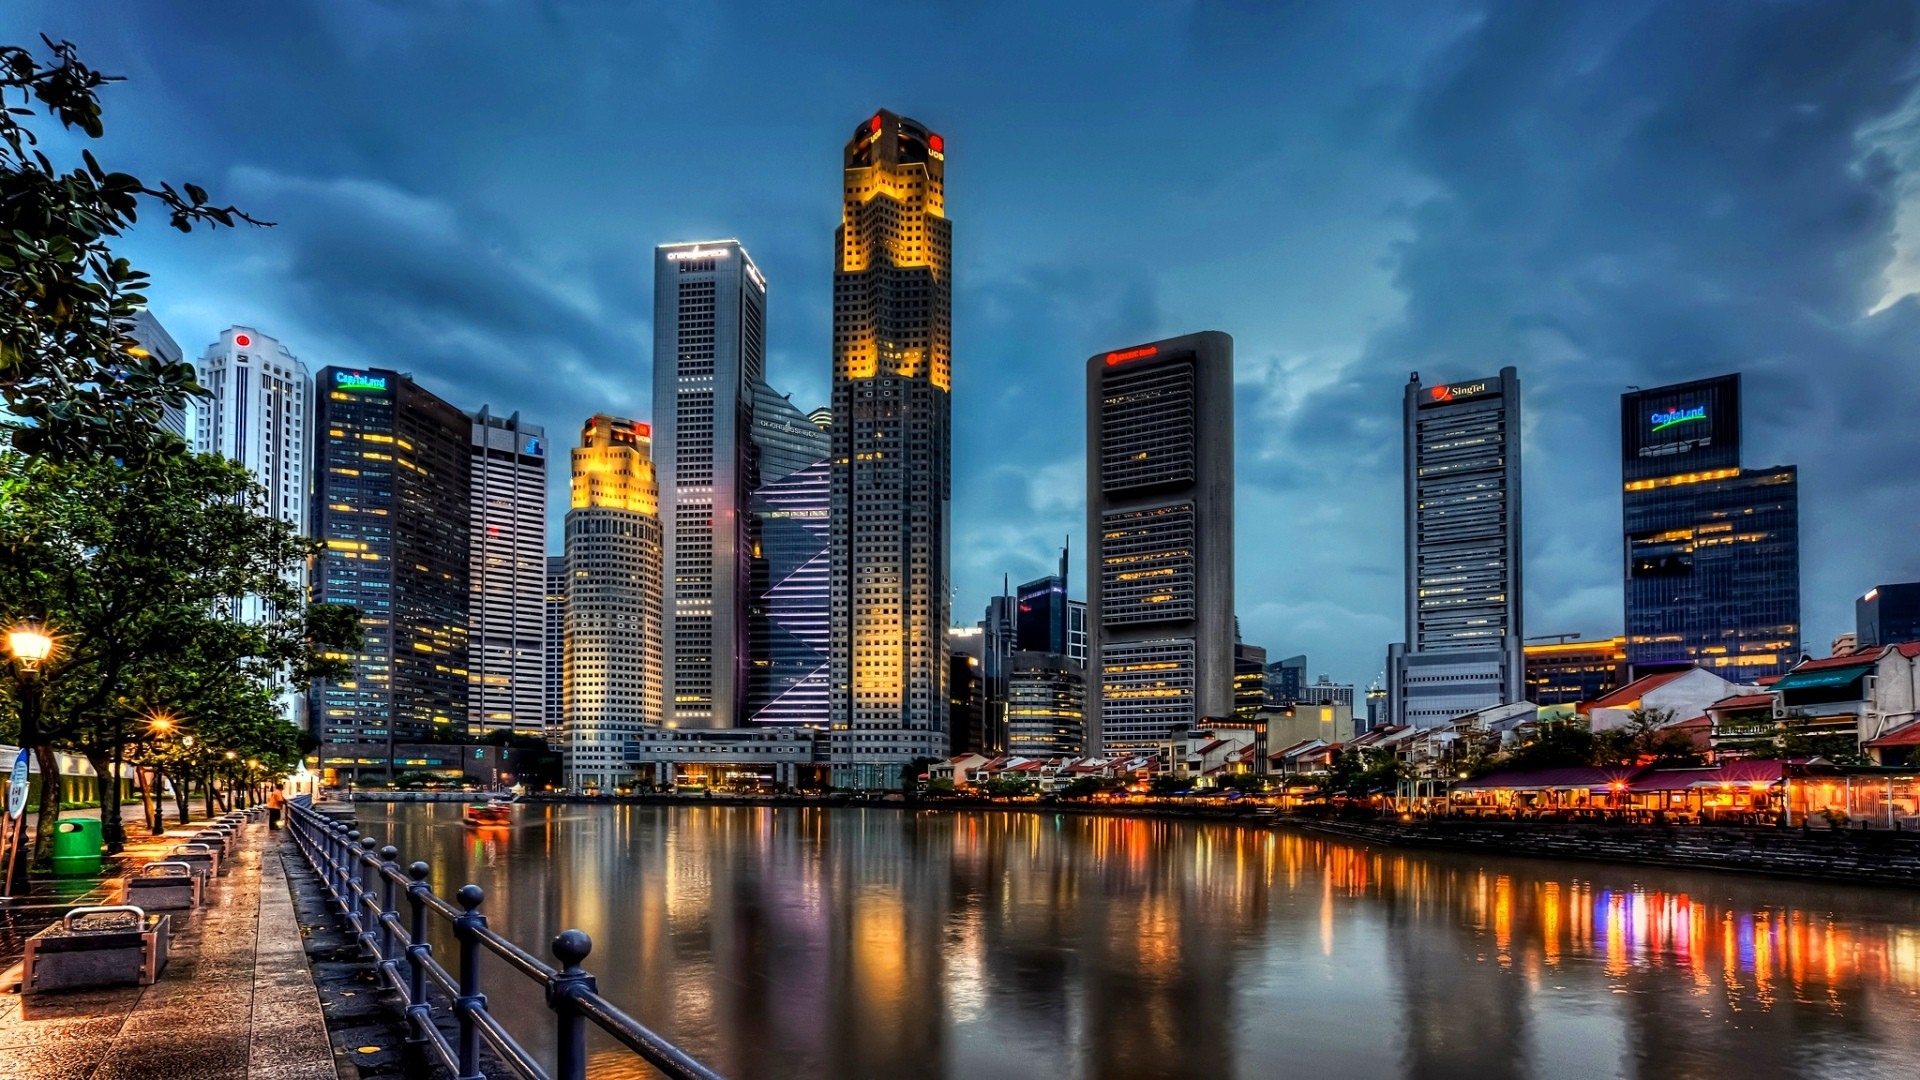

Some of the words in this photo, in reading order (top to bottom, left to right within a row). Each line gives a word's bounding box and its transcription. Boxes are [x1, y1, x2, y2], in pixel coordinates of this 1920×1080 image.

[928, 147, 944, 160] UOB
[336, 371, 386, 388] CapitaLand
[1452, 383, 1485, 396] SingTel
[1651, 406, 1704, 425] CapitaLand
